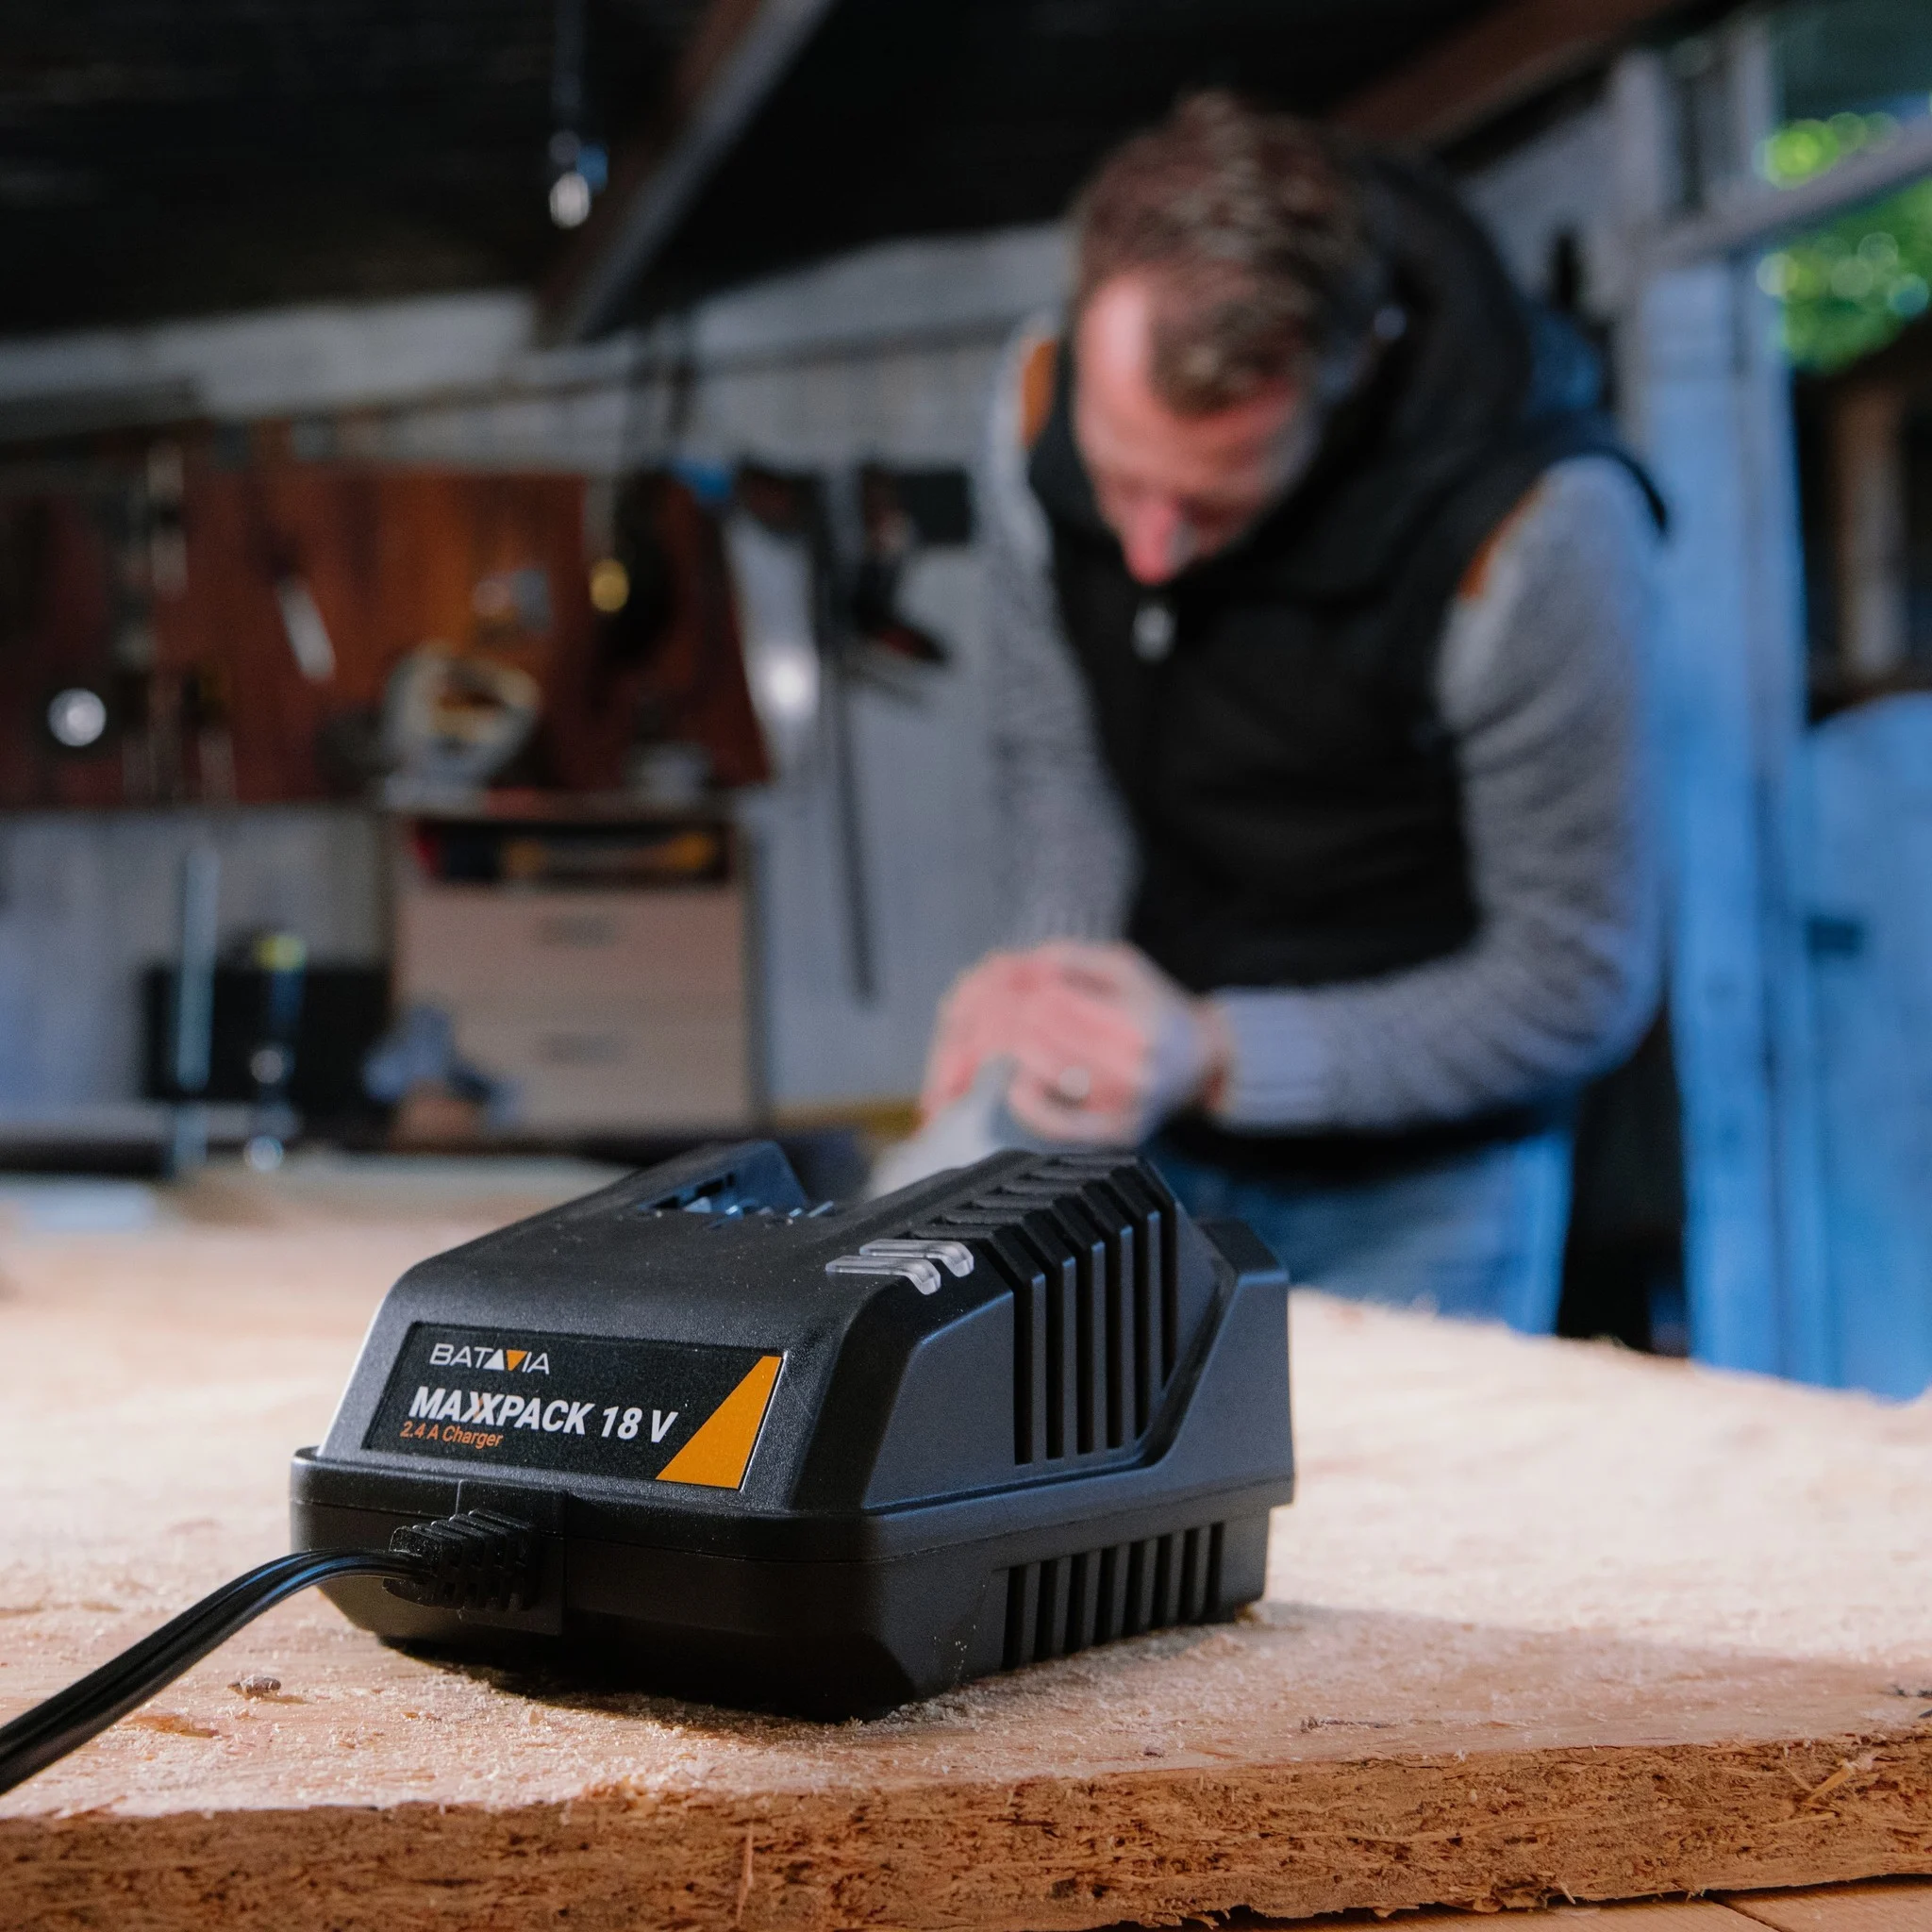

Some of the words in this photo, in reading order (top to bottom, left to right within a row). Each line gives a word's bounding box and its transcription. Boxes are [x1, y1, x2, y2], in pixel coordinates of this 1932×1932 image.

[429, 1342, 550, 1374] BATAVIA
[400, 1421, 426, 1439] 2.4
[426, 1424, 439, 1441] A
[441, 1425, 504, 1449] Charger
[601, 1406, 642, 1440] 18
[650, 1410, 678, 1443] V
